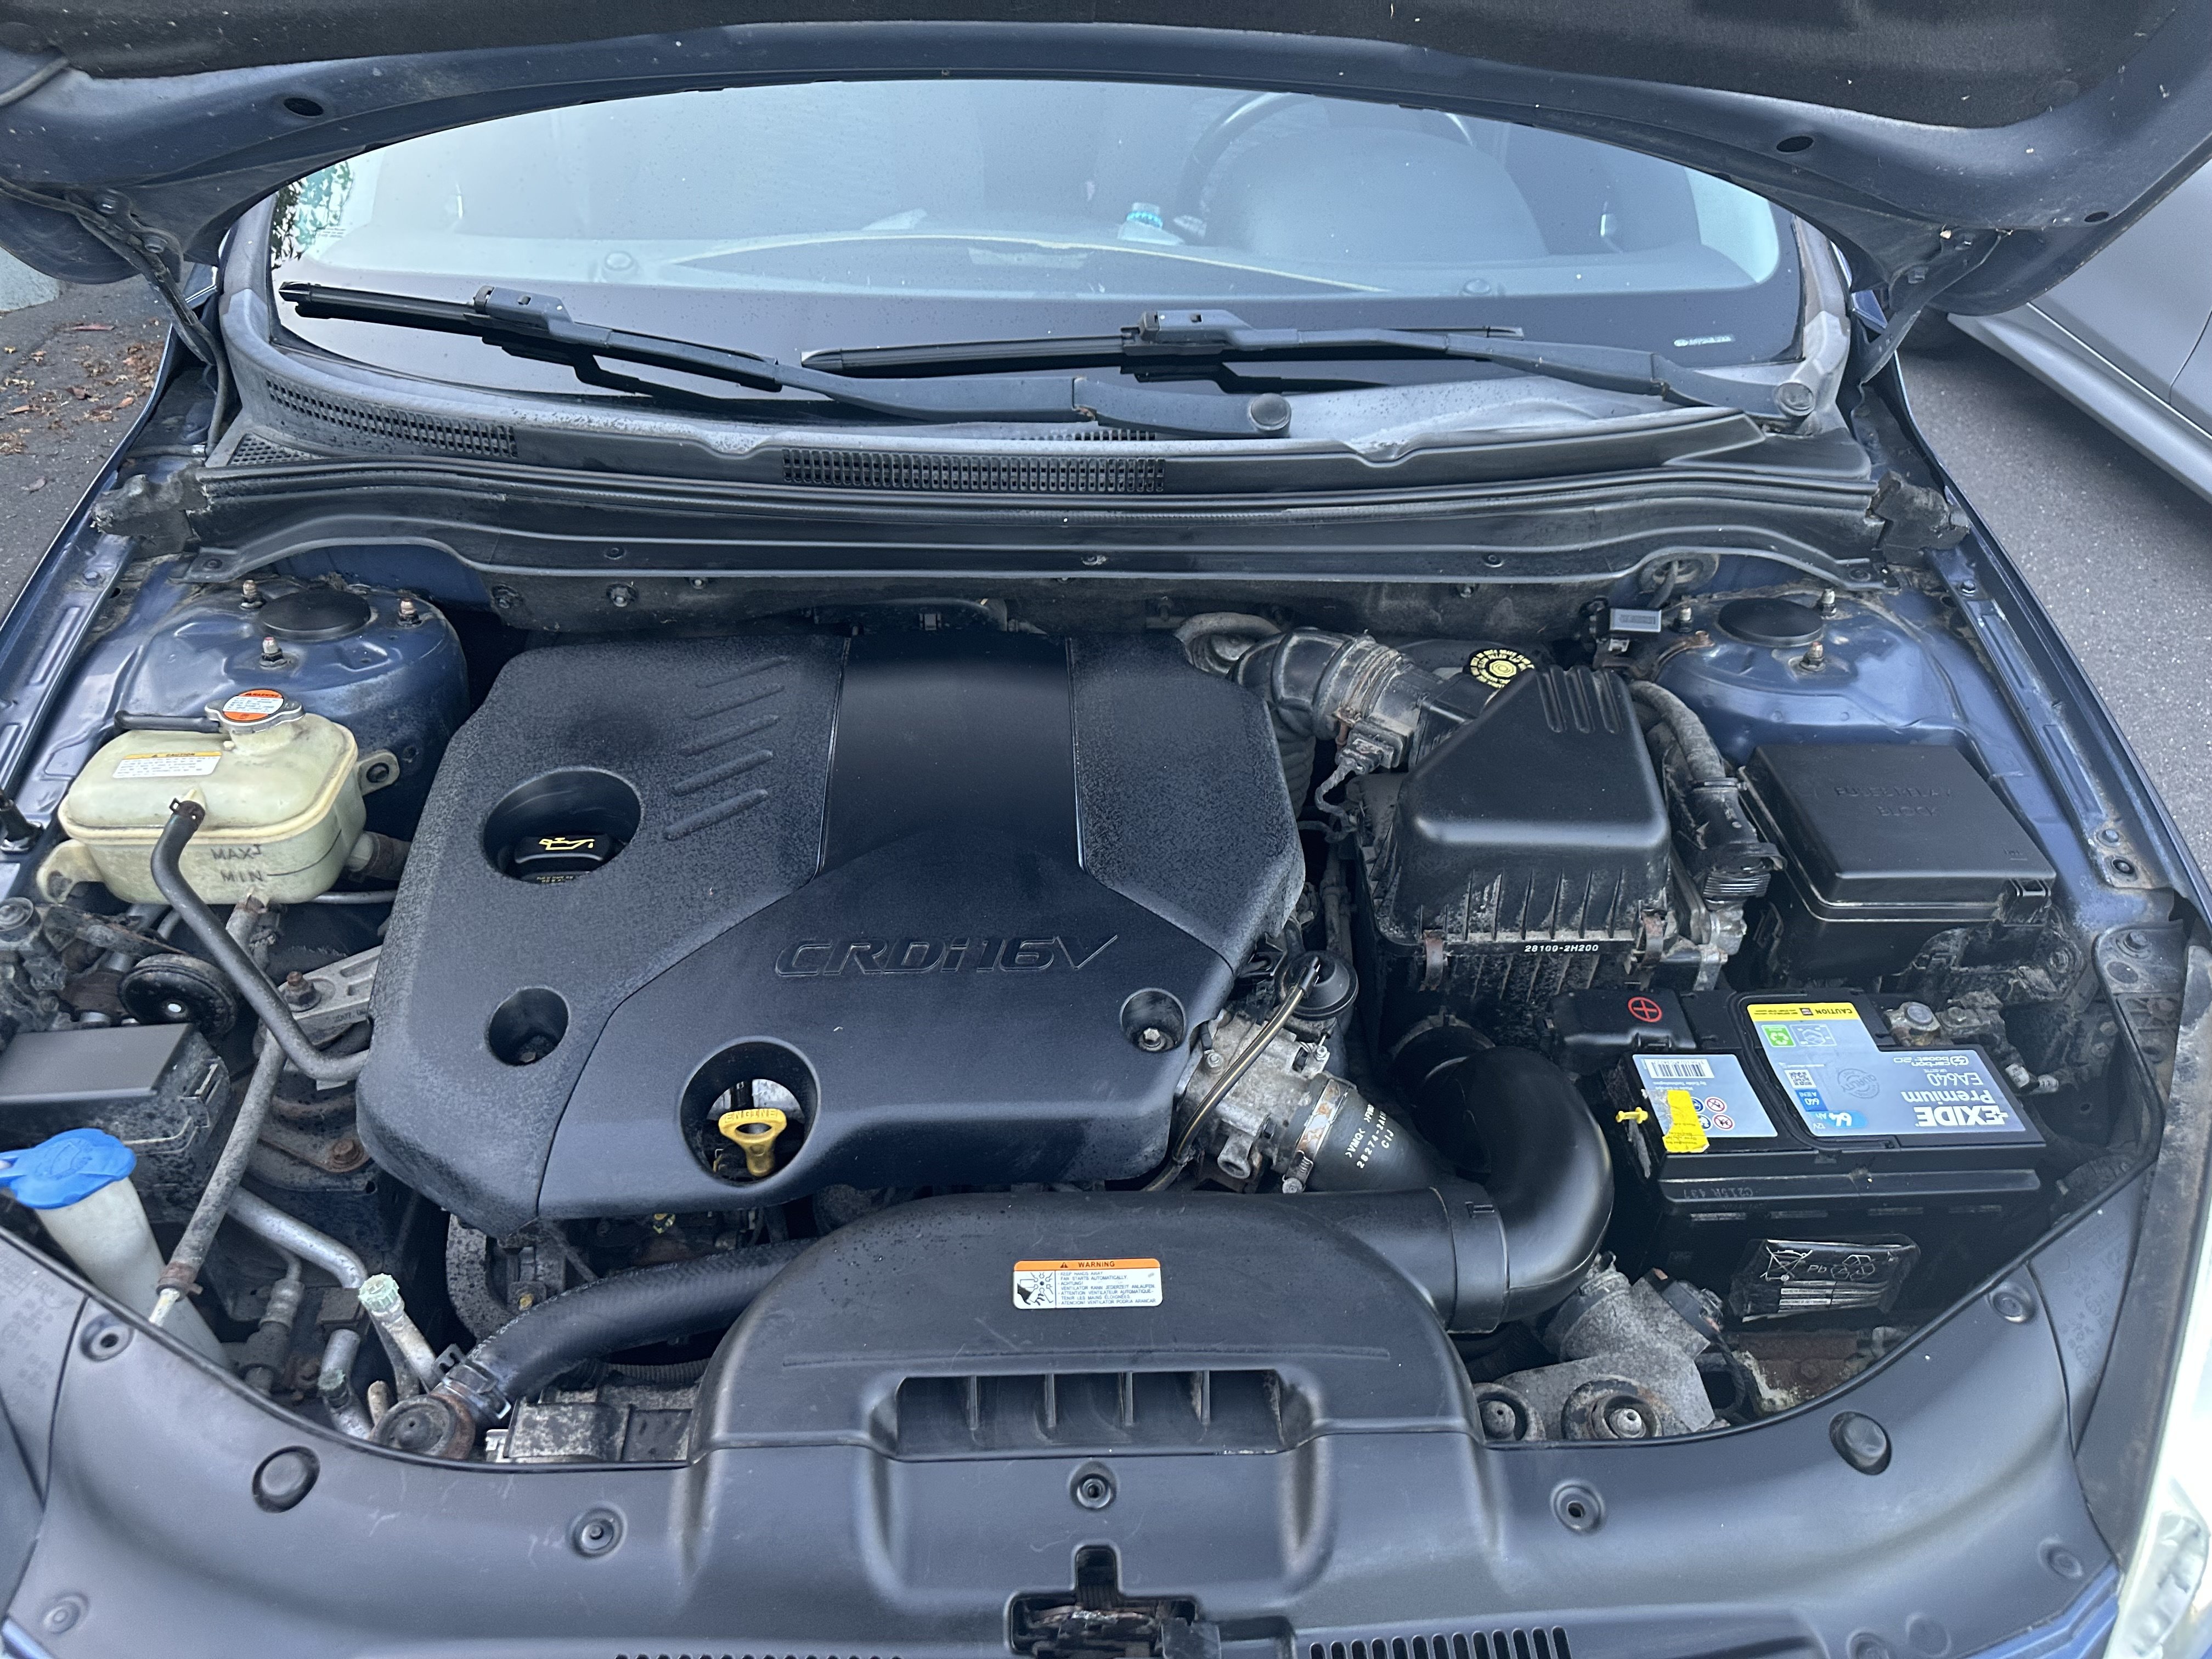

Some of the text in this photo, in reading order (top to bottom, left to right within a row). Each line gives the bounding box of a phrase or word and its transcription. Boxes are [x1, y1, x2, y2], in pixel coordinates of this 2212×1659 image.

[1876, 805, 1938, 817] BLOCK
[210, 848, 254, 860] MAX
[220, 870, 263, 882] MIN
[1525, 943, 1599, 953] 28100-2H200
[1841, 1074, 1877, 1092] QUALITY
[1926, 1072, 1984, 1086] EA640
[1900, 1090, 1996, 1105] Premium
[724, 1110, 778, 1124] ENGINE
[1829, 1112, 1852, 1126] 64
[1913, 1104, 2008, 1127] EXIDE
[1807, 1265, 1827, 1273] Pb
